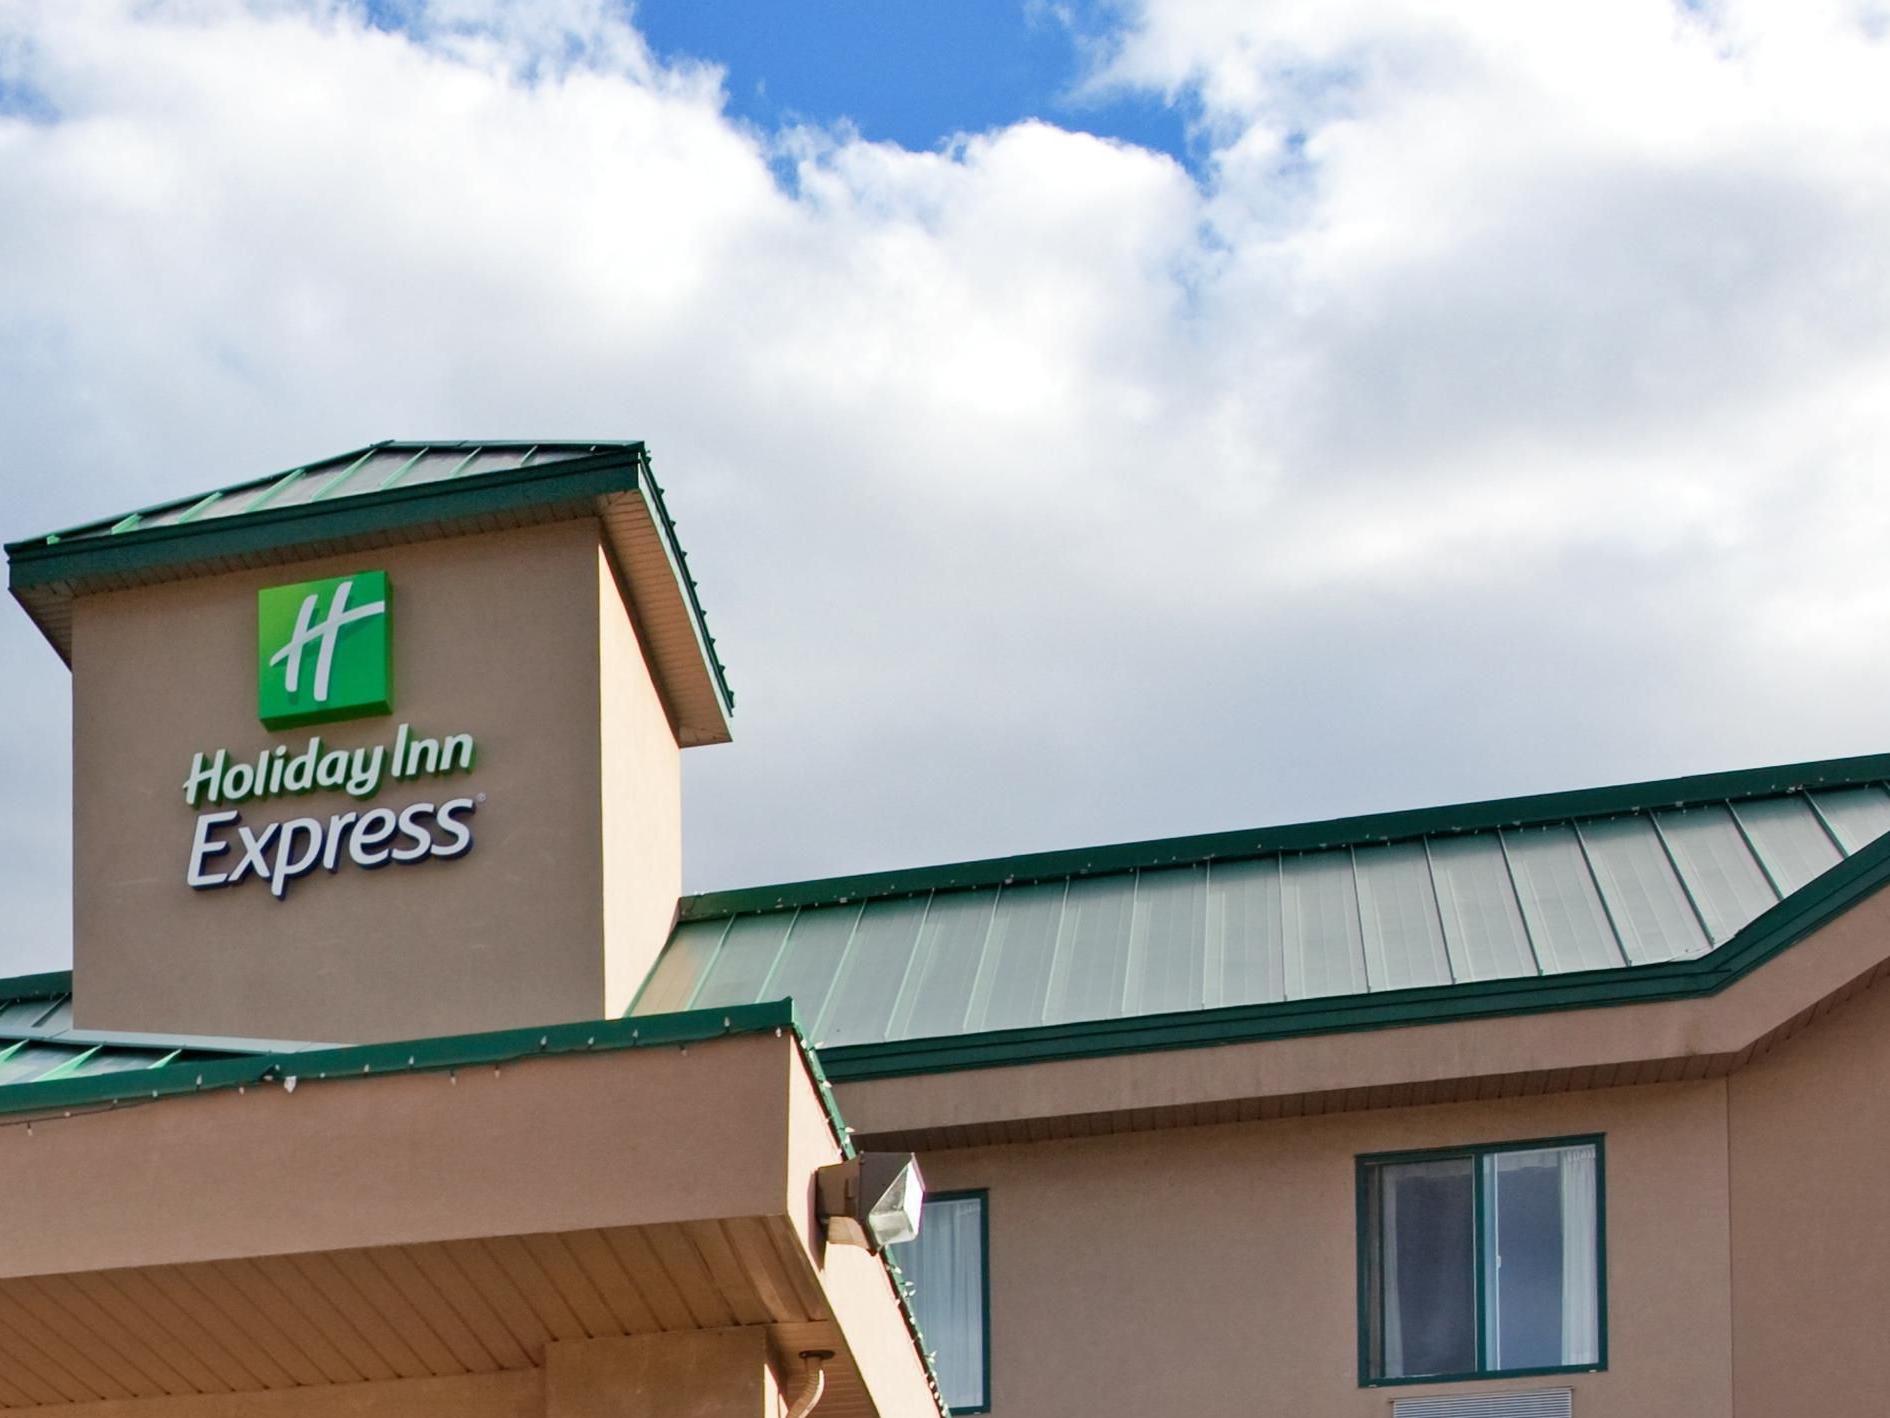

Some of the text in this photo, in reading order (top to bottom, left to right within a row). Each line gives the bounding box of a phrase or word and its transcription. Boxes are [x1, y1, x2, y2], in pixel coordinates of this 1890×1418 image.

[183, 723, 475, 805] Holiday Inn
[186, 797, 477, 899] Express
